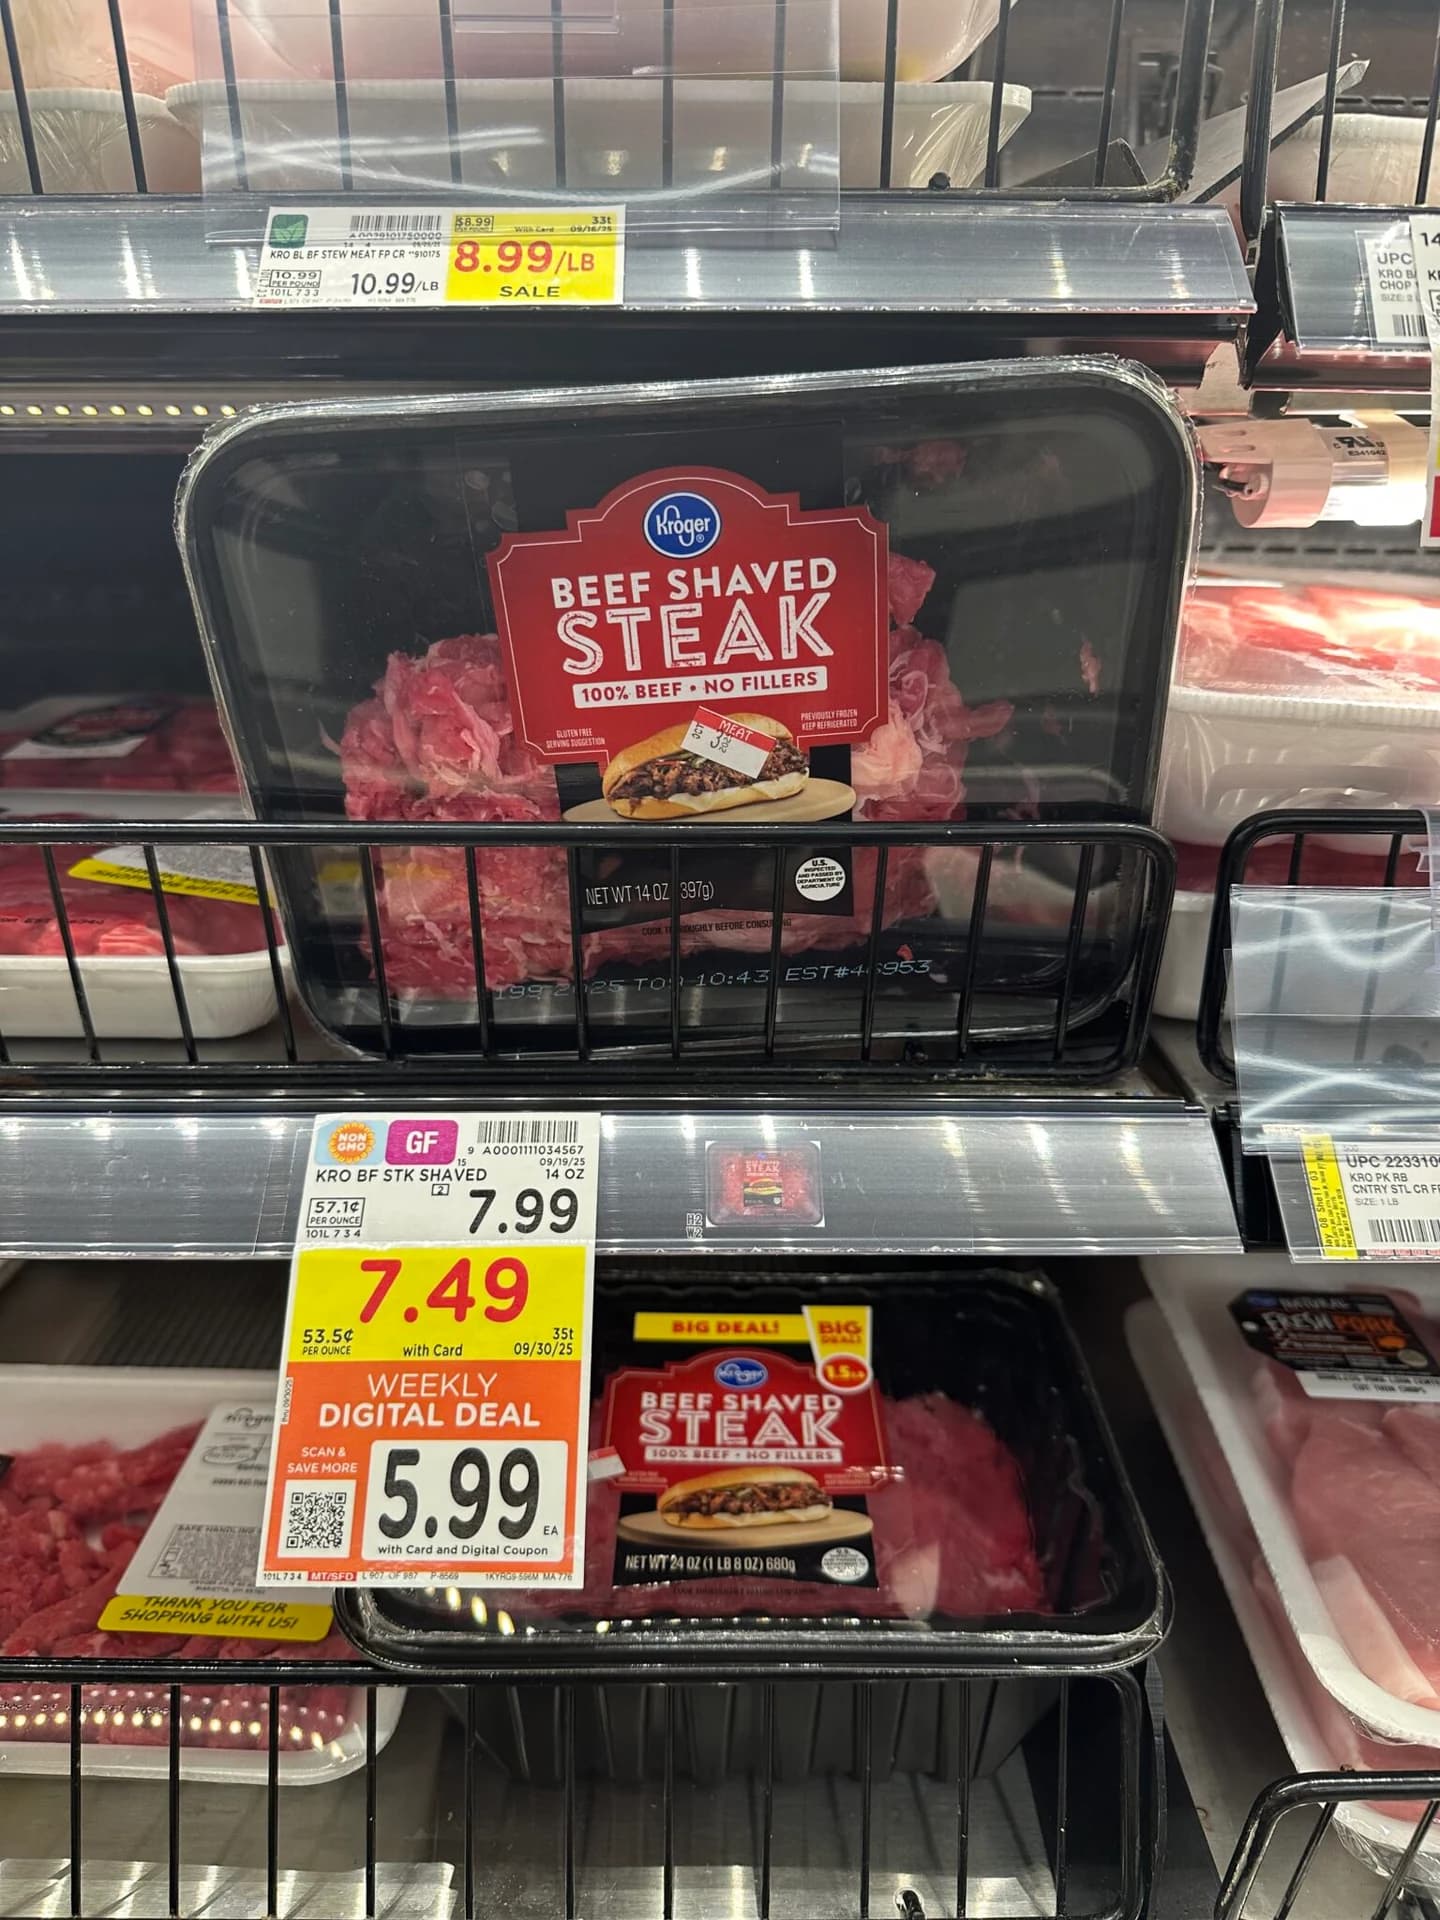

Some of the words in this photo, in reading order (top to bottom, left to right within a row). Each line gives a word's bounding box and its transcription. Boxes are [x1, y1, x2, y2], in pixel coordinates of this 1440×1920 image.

[592, 216, 611, 225] 33t
[270, 251, 290, 260] KRO
[293, 251, 304, 260] BL
[307, 251, 319, 259] BF
[321, 251, 348, 259] STEW
[350, 250, 375, 259] MEAT
[378, 250, 391, 259] FP
[392, 250, 405, 259] CR
[1377, 252, 1412, 265] UPC
[274, 271, 317, 280] 10.99
[1378, 268, 1402, 279] KRO
[500, 286, 560, 297] SALE
[1380, 280, 1411, 290] CHOP
[656, 504, 711, 547] Kroger
[551, 571, 652, 609] BEEF
[668, 557, 837, 601] SHAVED
[556, 591, 834, 676] STEAK
[581, 685, 630, 703] 100%
[635, 681, 682, 699] BEEF
[704, 677, 735, 694] NO
[741, 672, 818, 691] FILLERS
[835, 709, 857, 718] FROZEN
[719, 719, 754, 741] MEAT
[802, 721, 816, 730] KEEP
[817, 719, 857, 729] REFRIGERATED
[556, 729, 578, 738] GLUTEN
[579, 728, 592, 737] FREE
[546, 739, 570, 748] SERVING
[571, 737, 605, 747] SUGGESTION
[586, 887, 609, 905] NET
[611, 885, 632, 903] WT
[635, 884, 650, 902] 14
[653, 883, 671, 900] OZ
[715, 921, 744, 931] BEFORE
[696, 969, 770, 987] 10:43
[338, 1133, 366, 1142] NON
[405, 1131, 439, 1154] GF
[337, 1142, 366, 1152] GMO
[457, 1159, 467, 1167] 15
[540, 1158, 586, 1167] 09/19/25
[1346, 1155, 1381, 1168] UPC
[316, 1169, 351, 1182] KRO
[357, 1169, 379, 1182] BF
[383, 1169, 414, 1182] STK
[419, 1169, 487, 1182] SHAVED
[545, 1169, 559, 1180] 14
[564, 1169, 584, 1180] OZ
[1349, 1173, 1373, 1182] KRO
[1376, 1173, 1391, 1182] PK
[1393, 1173, 1408, 1182] RB
[1352, 1184, 1388, 1194] CNTRY
[1391, 1184, 1411, 1194] STL
[1413, 1184, 1429, 1194] CR
[314, 1200, 359, 1214] 57.1¢
[469, 1188, 579, 1234] 7.99
[310, 1217, 328, 1225] PER
[330, 1216, 360, 1225] OUNCE
[359, 1257, 529, 1324] 7.49
[552, 1327, 574, 1340] 35t
[672, 1321, 710, 1334] BIG
[716, 1321, 780, 1334] DEAL!
[819, 1321, 862, 1334] BIG
[303, 1328, 354, 1344] 53.5¢
[302, 1346, 319, 1355] PER
[321, 1345, 351, 1355] OUNCE
[403, 1344, 430, 1357] with
[433, 1344, 463, 1357] Card
[513, 1342, 573, 1357] 09/30/25
[368, 1373, 498, 1398] WEEKLY
[641, 1392, 712, 1410] BEEF
[724, 1394, 843, 1411] SHAVED
[319, 1402, 444, 1427] DIGITAL
[455, 1402, 541, 1427] DEAL
[639, 1409, 844, 1446] STEAK
[302, 1447, 335, 1458] SCAN
[338, 1447, 346, 1458] &
[693, 1449, 730, 1460] BEEF
[776, 1451, 834, 1461] FILLERS
[287, 1462, 319, 1473] SAVE
[322, 1462, 358, 1473] MORE
[378, 1447, 540, 1540] 5.99
[543, 1525, 559, 1536] EA
[378, 1544, 404, 1555] with
[406, 1544, 435, 1555] Card
[437, 1544, 459, 1555] and
[461, 1544, 500, 1556] Digital
[503, 1545, 549, 1557] Coupon
[626, 1555, 646, 1569] NET
[648, 1555, 669, 1570] WT
[670, 1555, 684, 1570] 24
[687, 1556, 701, 1570] OZ
[717, 1556, 731, 1570] LB
[766, 1557, 796, 1573] 680g
[310, 1572, 353, 1581] MT/SFD
[144, 1596, 202, 1609] THANK
[208, 1599, 246, 1613] YOU
[251, 1602, 288, 1615] FOR
[120, 1609, 213, 1624] SHOPPING
[217, 1612, 263, 1627] WITH
[269, 1616, 299, 1629] US!
